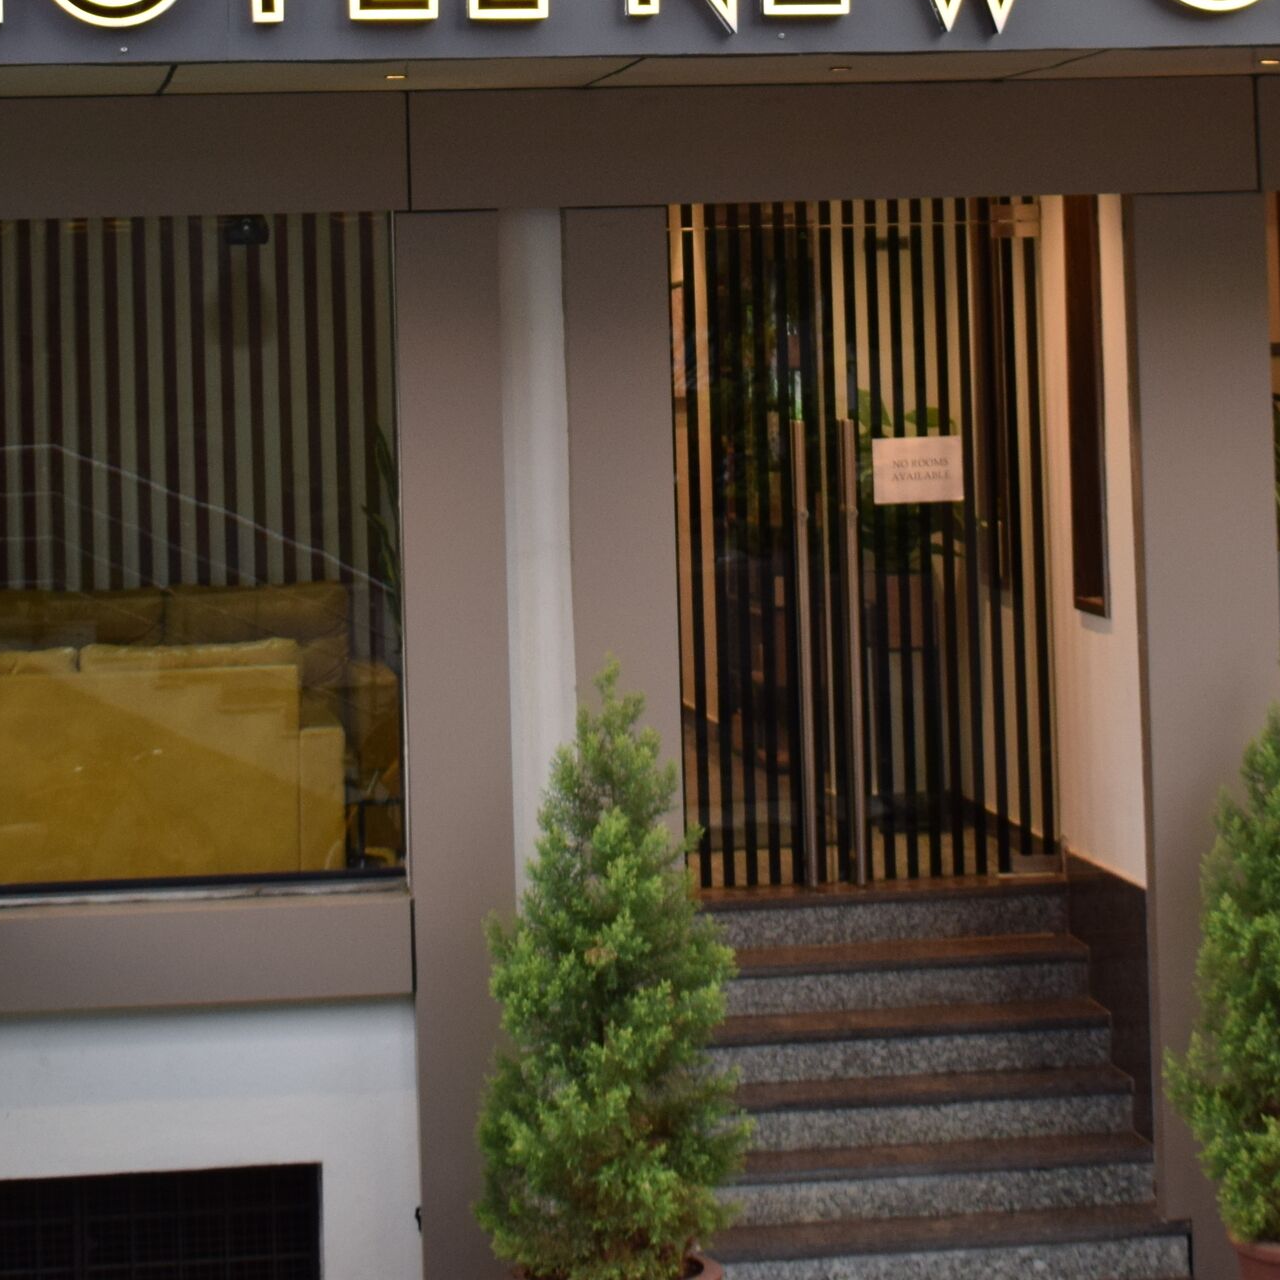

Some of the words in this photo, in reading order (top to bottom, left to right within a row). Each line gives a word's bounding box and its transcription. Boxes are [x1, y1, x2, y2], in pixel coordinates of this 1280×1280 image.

[892, 458, 909, 469] NO
[911, 457, 950, 468] ROOMS
[892, 470, 951, 481] AVAILABLE
